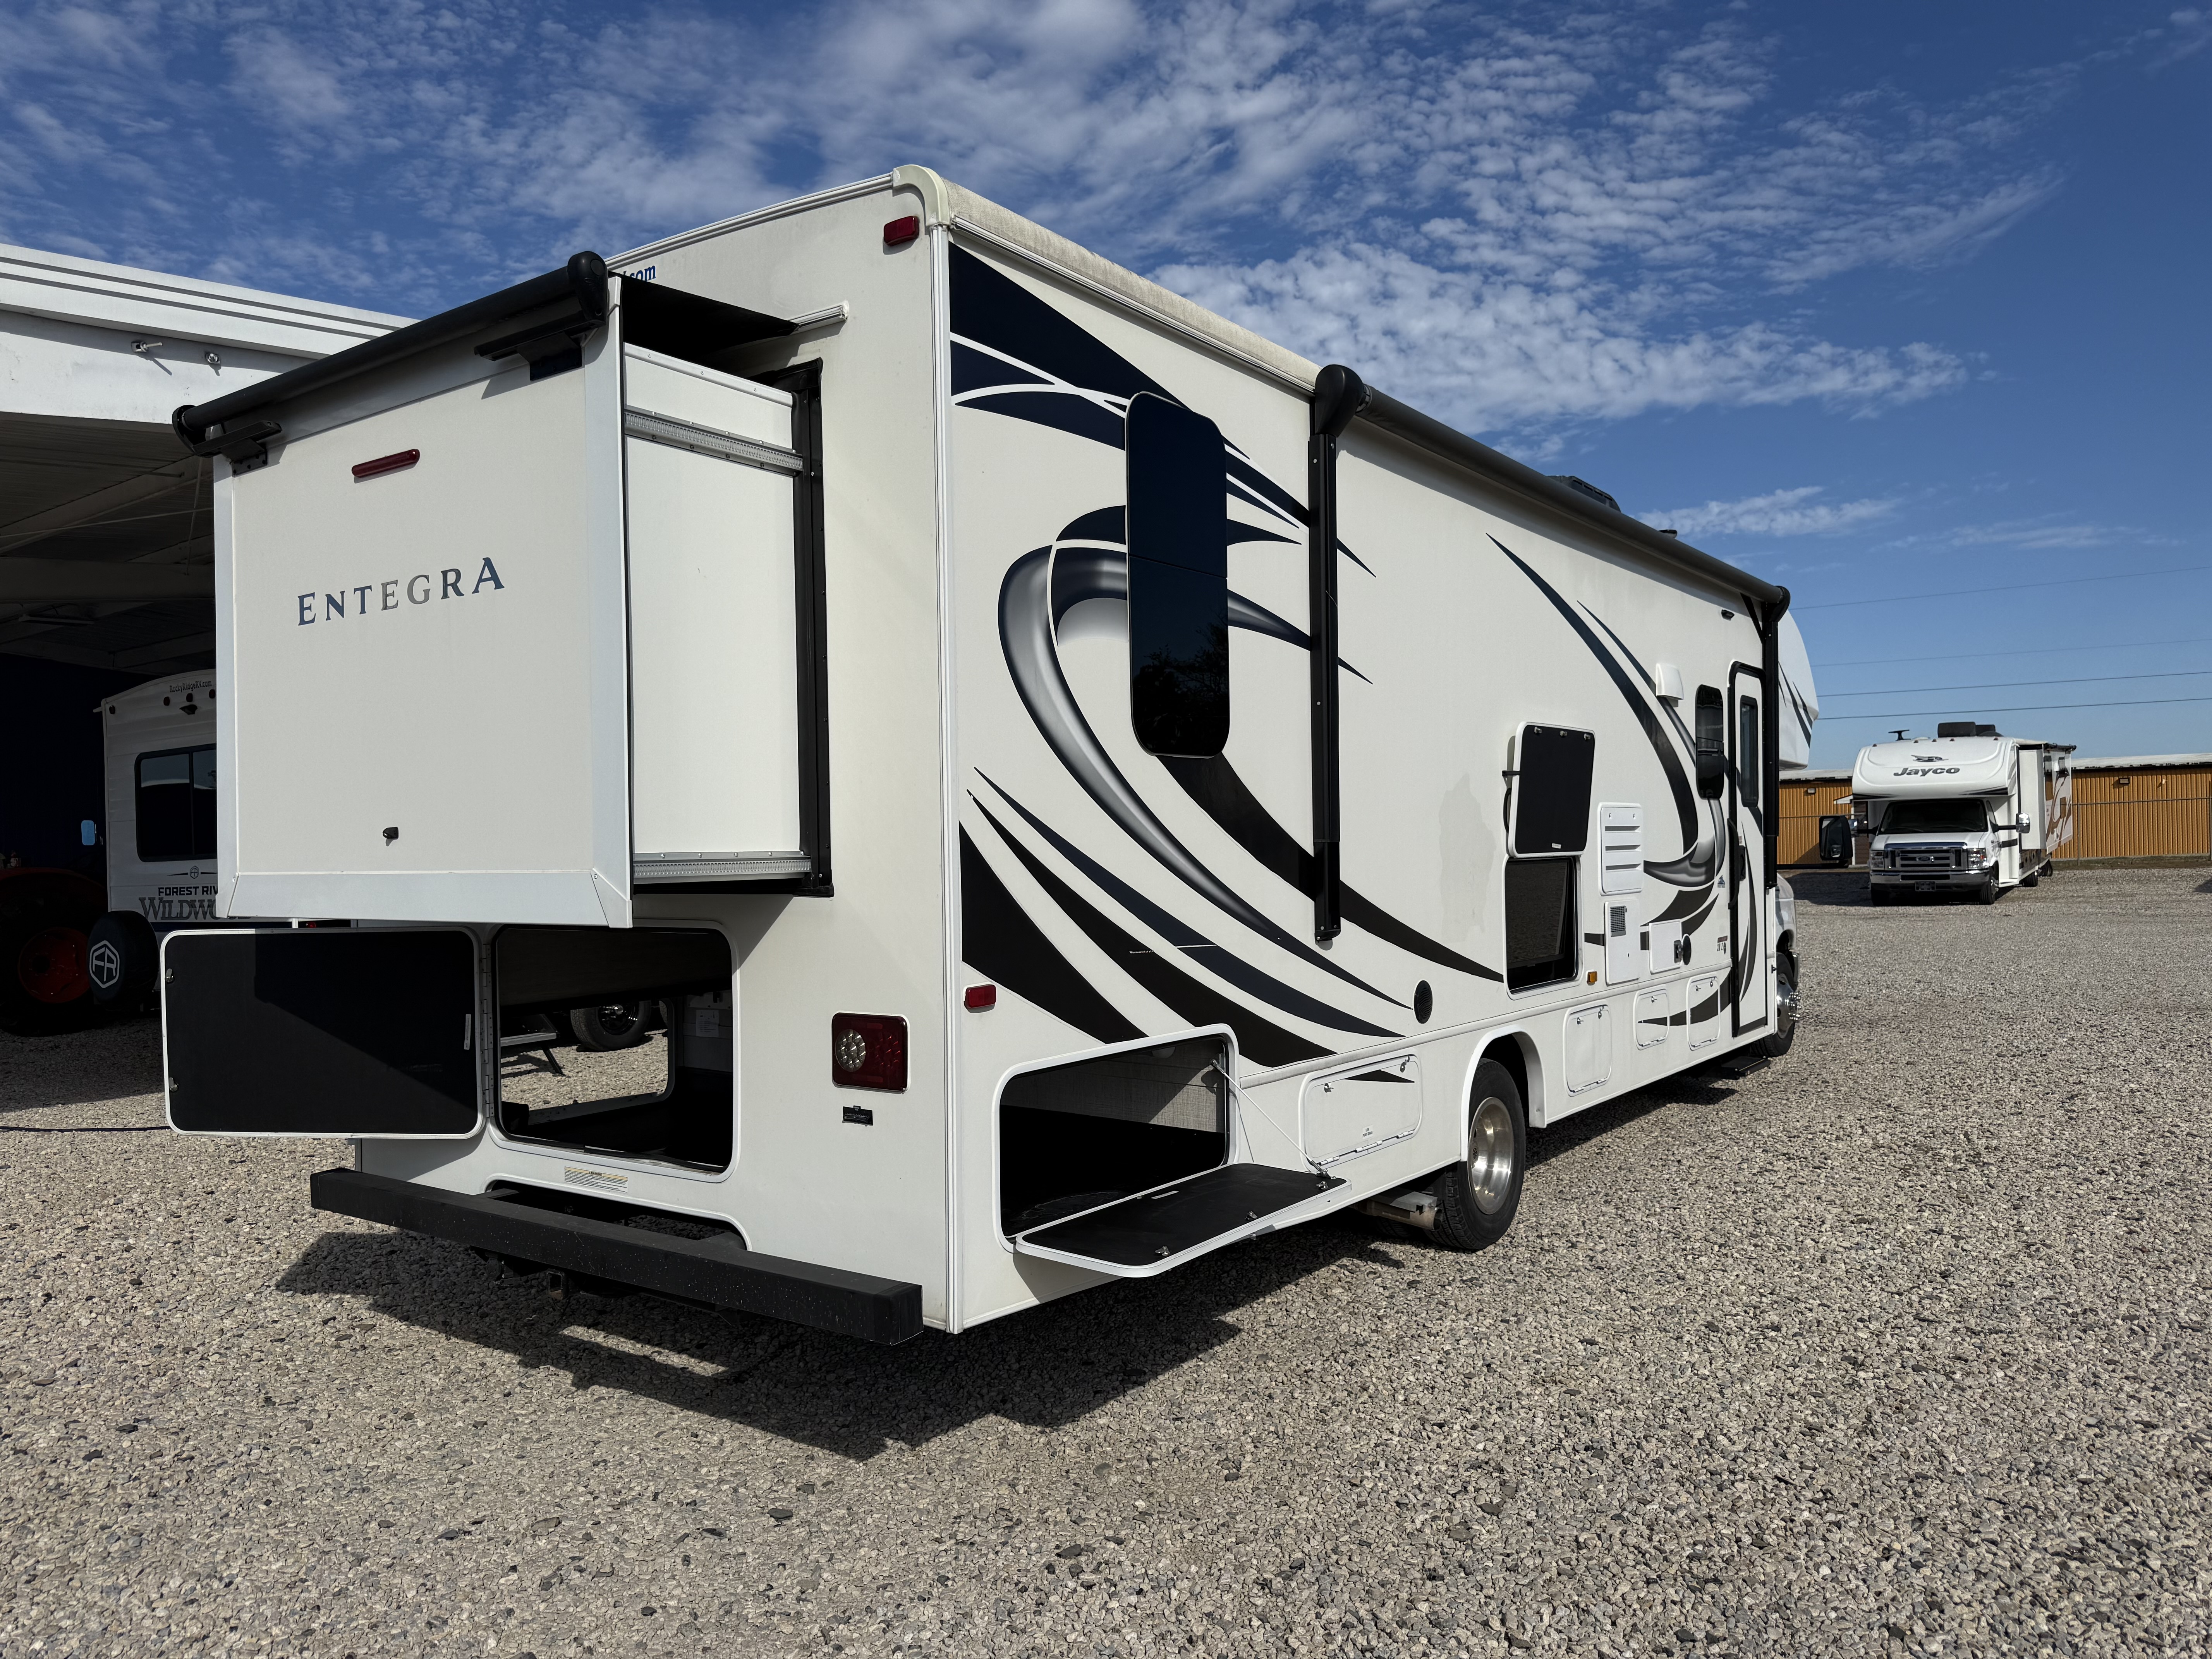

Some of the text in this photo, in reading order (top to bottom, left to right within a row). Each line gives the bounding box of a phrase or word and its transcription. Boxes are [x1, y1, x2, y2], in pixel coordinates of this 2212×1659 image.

[298, 556, 505, 626] ENTEGRA
[1893, 767, 1960, 776] Jayco
[158, 885, 218, 896] FOREST RIV
[139, 896, 251, 920] WILDW
